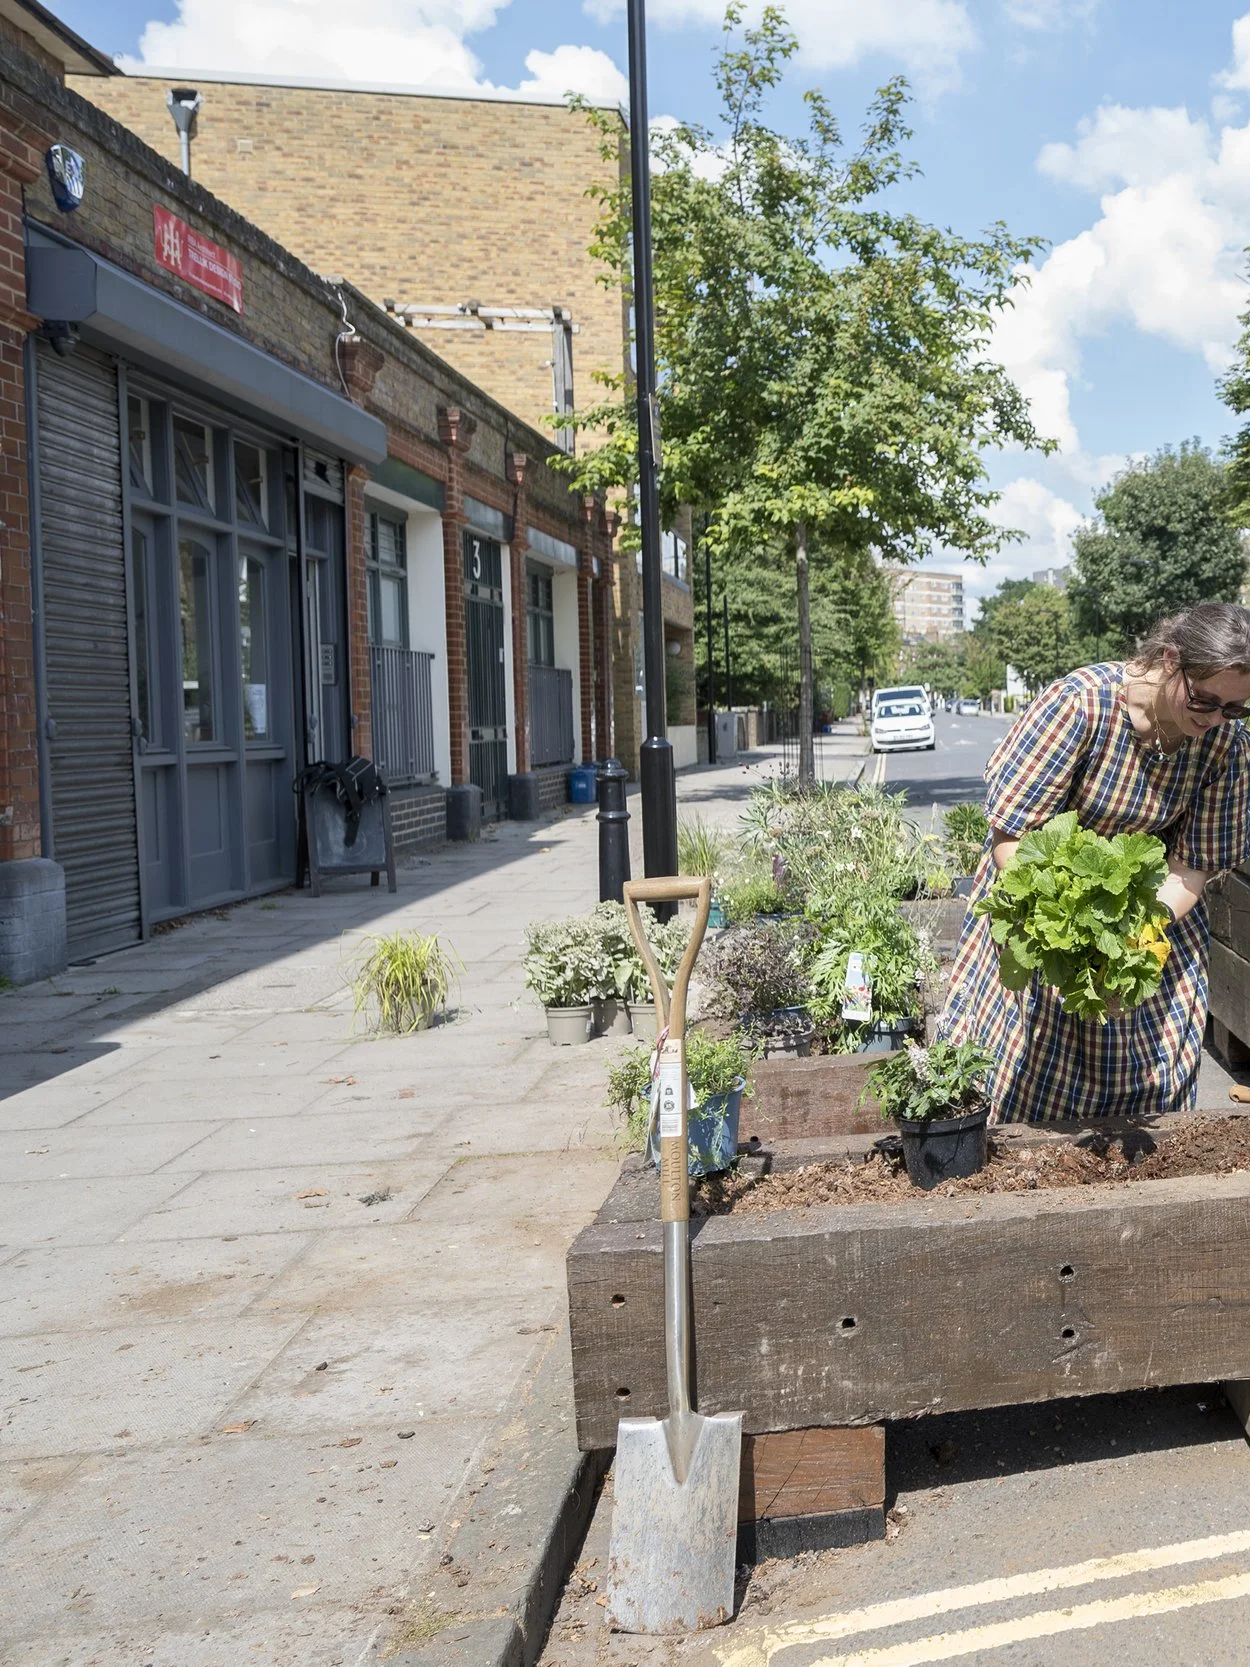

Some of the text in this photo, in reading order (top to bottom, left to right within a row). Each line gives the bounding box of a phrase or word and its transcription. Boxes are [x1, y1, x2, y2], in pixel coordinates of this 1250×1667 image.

[472, 540, 481, 579] 3
[661, 1158, 671, 1184] MILL
[670, 1141, 681, 1201] MOULTON
